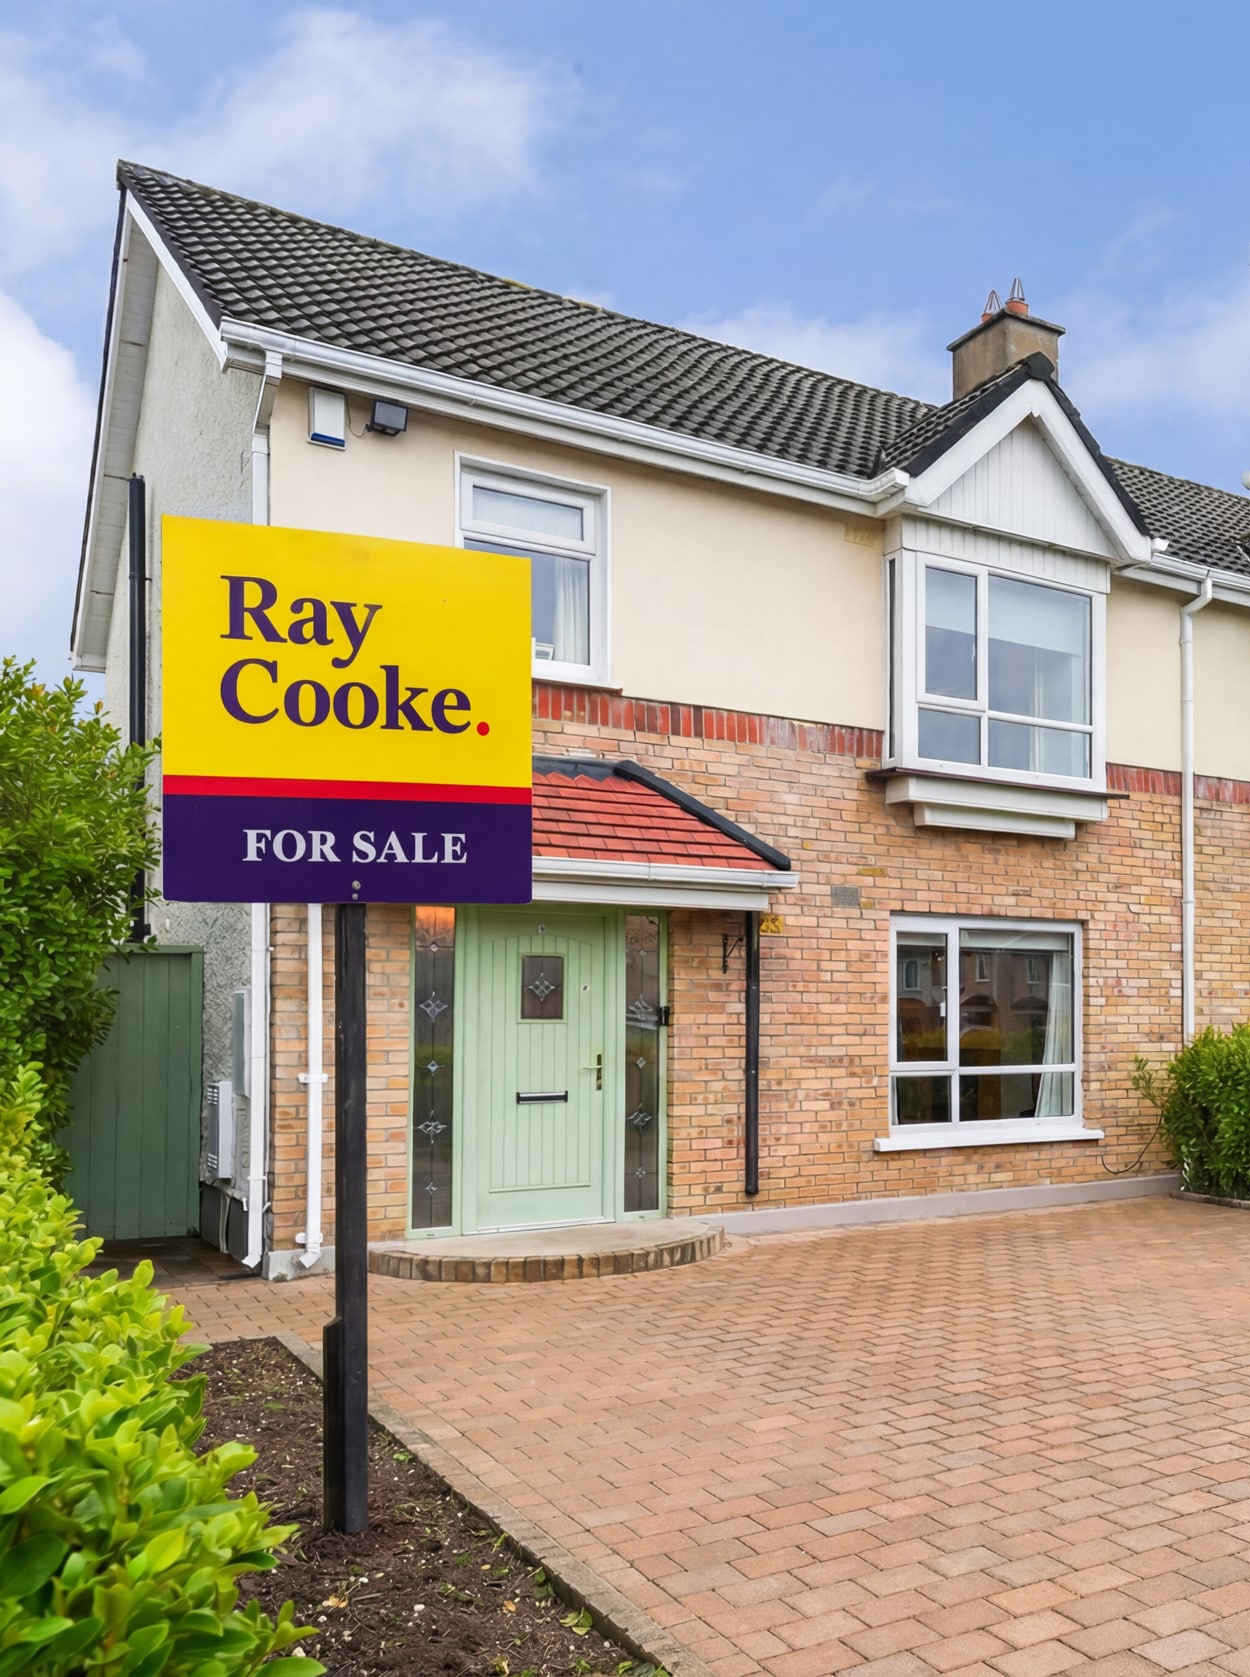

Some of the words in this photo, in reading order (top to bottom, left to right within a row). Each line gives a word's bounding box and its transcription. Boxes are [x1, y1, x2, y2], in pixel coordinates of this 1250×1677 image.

[220, 574, 383, 669] Ray
[220, 658, 491, 737] Cooke.
[242, 829, 341, 863] FOR
[351, 830, 468, 864] SALE
